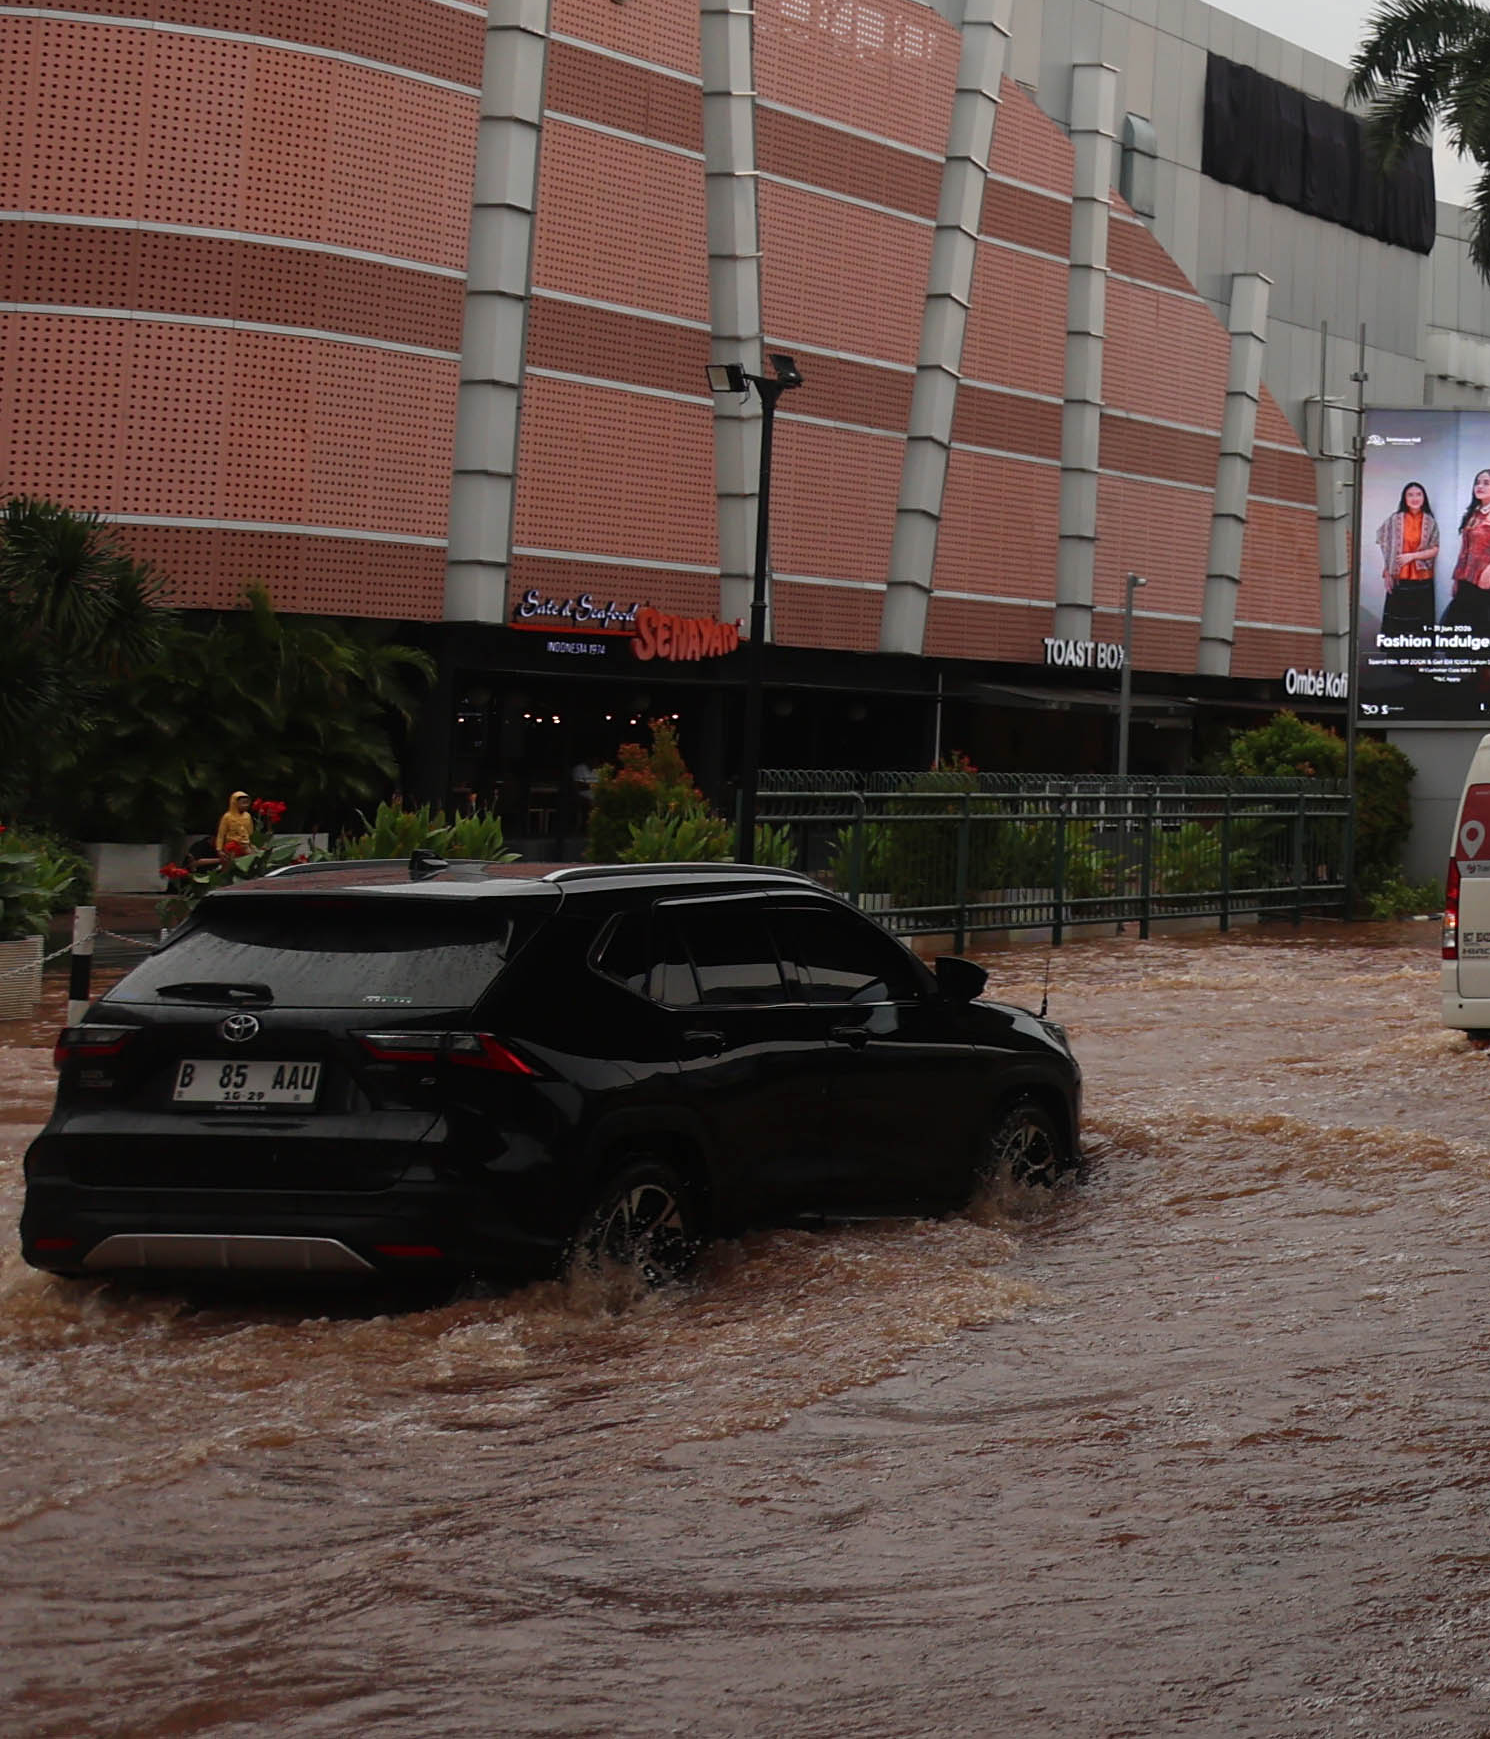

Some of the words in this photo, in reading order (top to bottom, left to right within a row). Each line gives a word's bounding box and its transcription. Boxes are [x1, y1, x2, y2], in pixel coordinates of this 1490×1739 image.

[518, 589, 560, 618] Sate
[575, 593, 642, 629] Seafood
[546, 640, 588, 655] INDONESIA
[632, 606, 740, 662] SENAYAN
[1376, 634, 1432, 648] Fashion
[1043, 638, 1095, 668] TOAST
[1284, 667, 1325, 698] Ombé
[179, 1063, 195, 1089] B
[219, 1063, 249, 1089] 85
[272, 1064, 317, 1090] AAU
